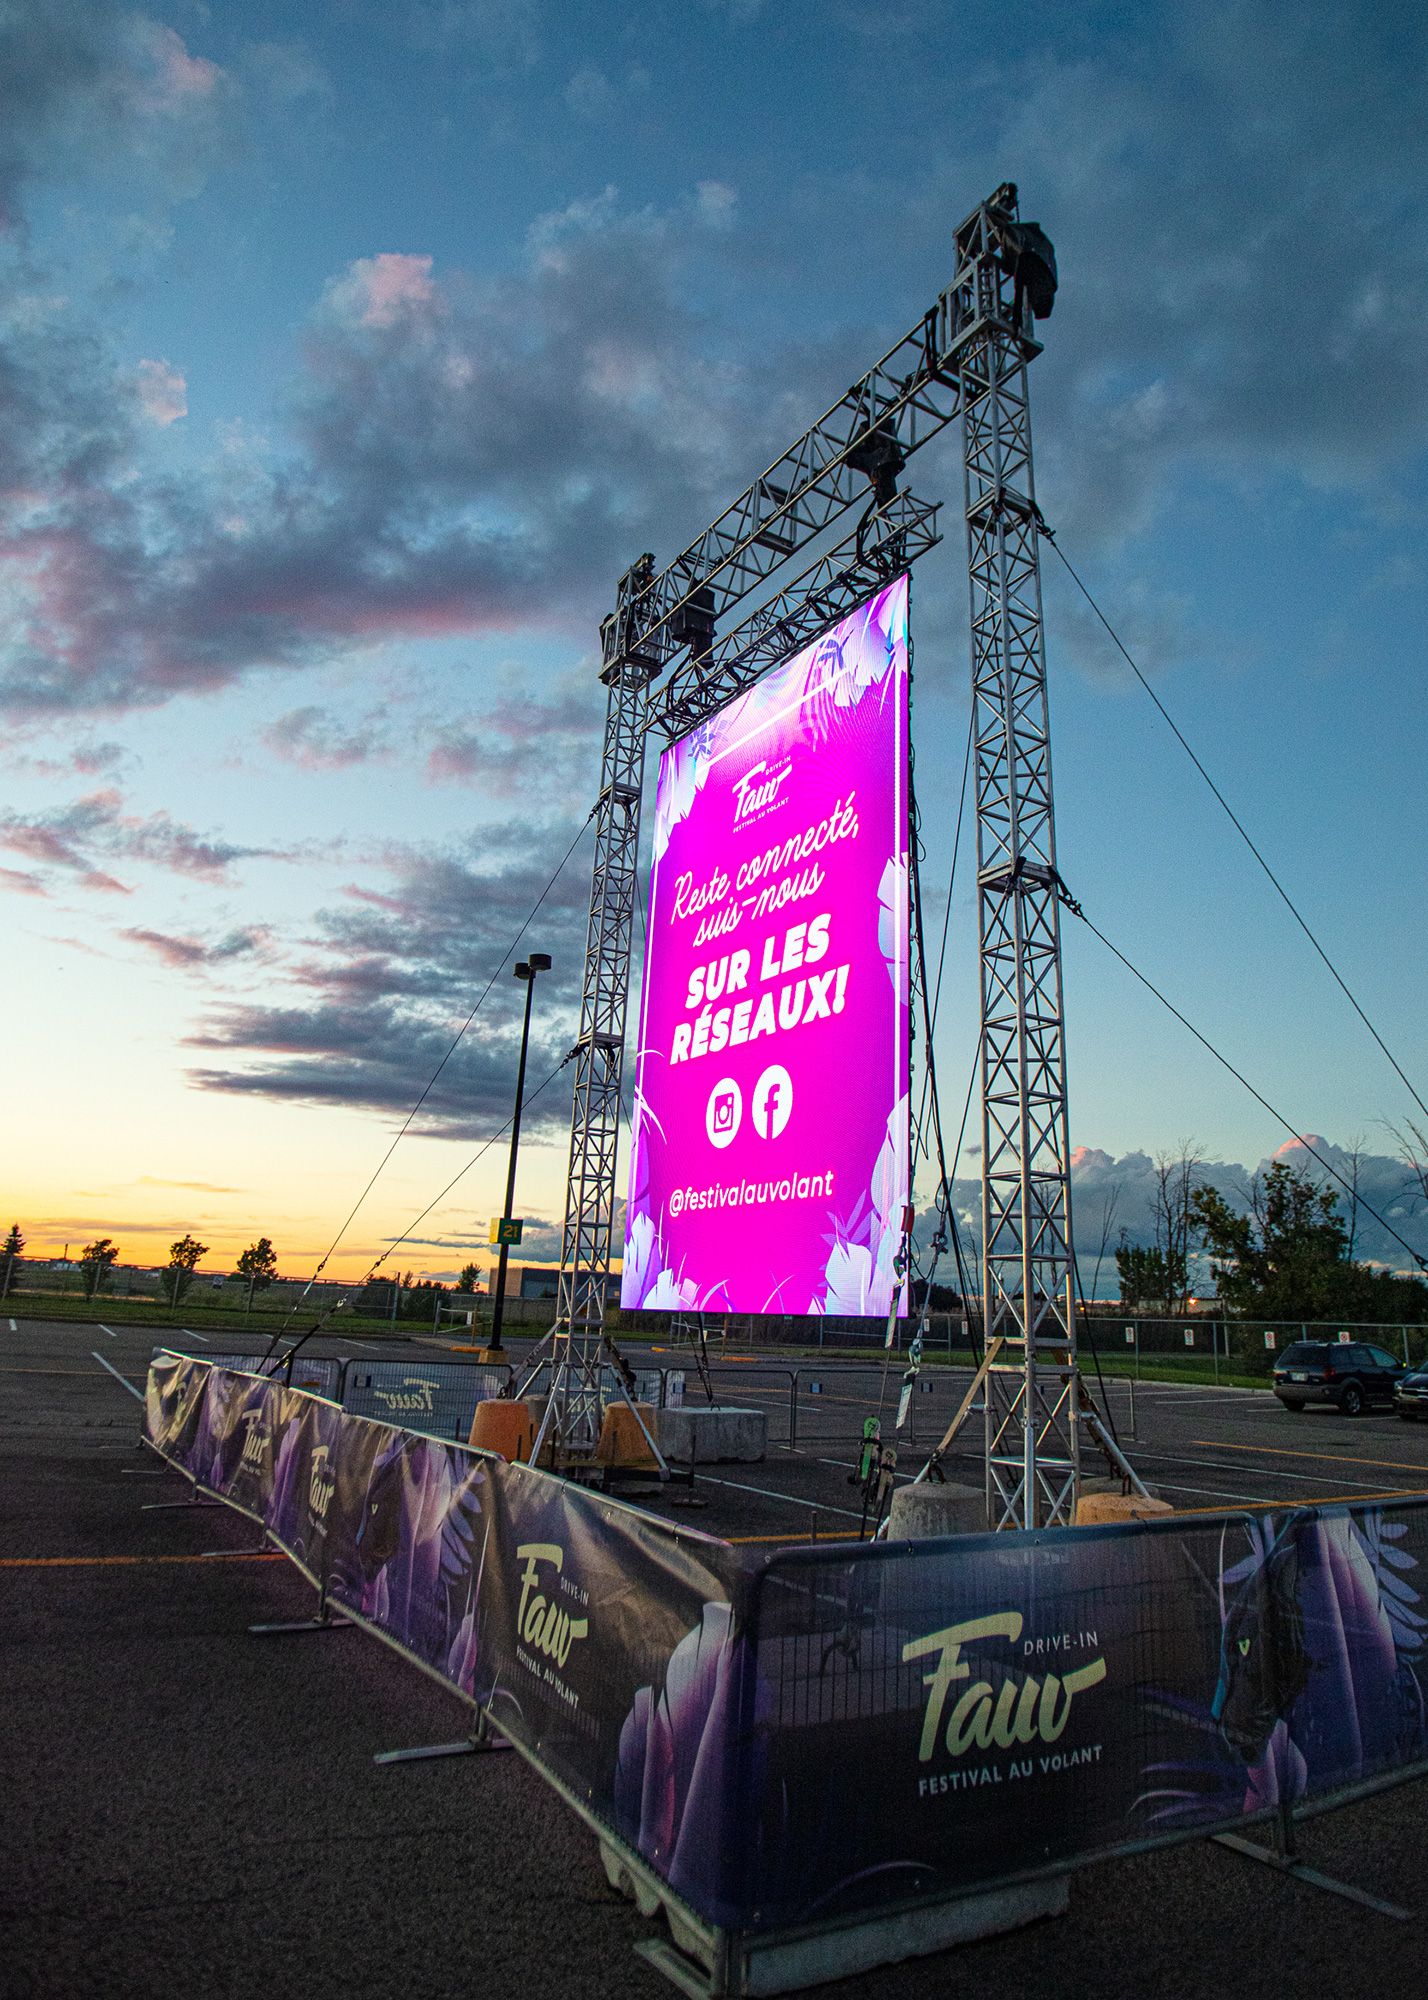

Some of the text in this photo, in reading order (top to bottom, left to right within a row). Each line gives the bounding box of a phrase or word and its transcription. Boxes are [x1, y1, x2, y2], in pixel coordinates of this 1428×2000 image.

[670, 791, 859, 926] Reste connecté,
[693, 862, 826, 948] suis-nous
[685, 913, 832, 1009] SUR LES
[669, 964, 850, 1066] RÉSEAUX!
[669, 1170, 834, 1217] @festivalauvolant
[503, 1225, 518, 1238] 21
[560, 1577, 590, 1606] DRIVE-IN
[1023, 1630, 1099, 1656] DRIVE-IN
[543, 1667, 555, 1686] AU
[918, 1746, 1103, 1797] FESTIVAL AU VOLANT
